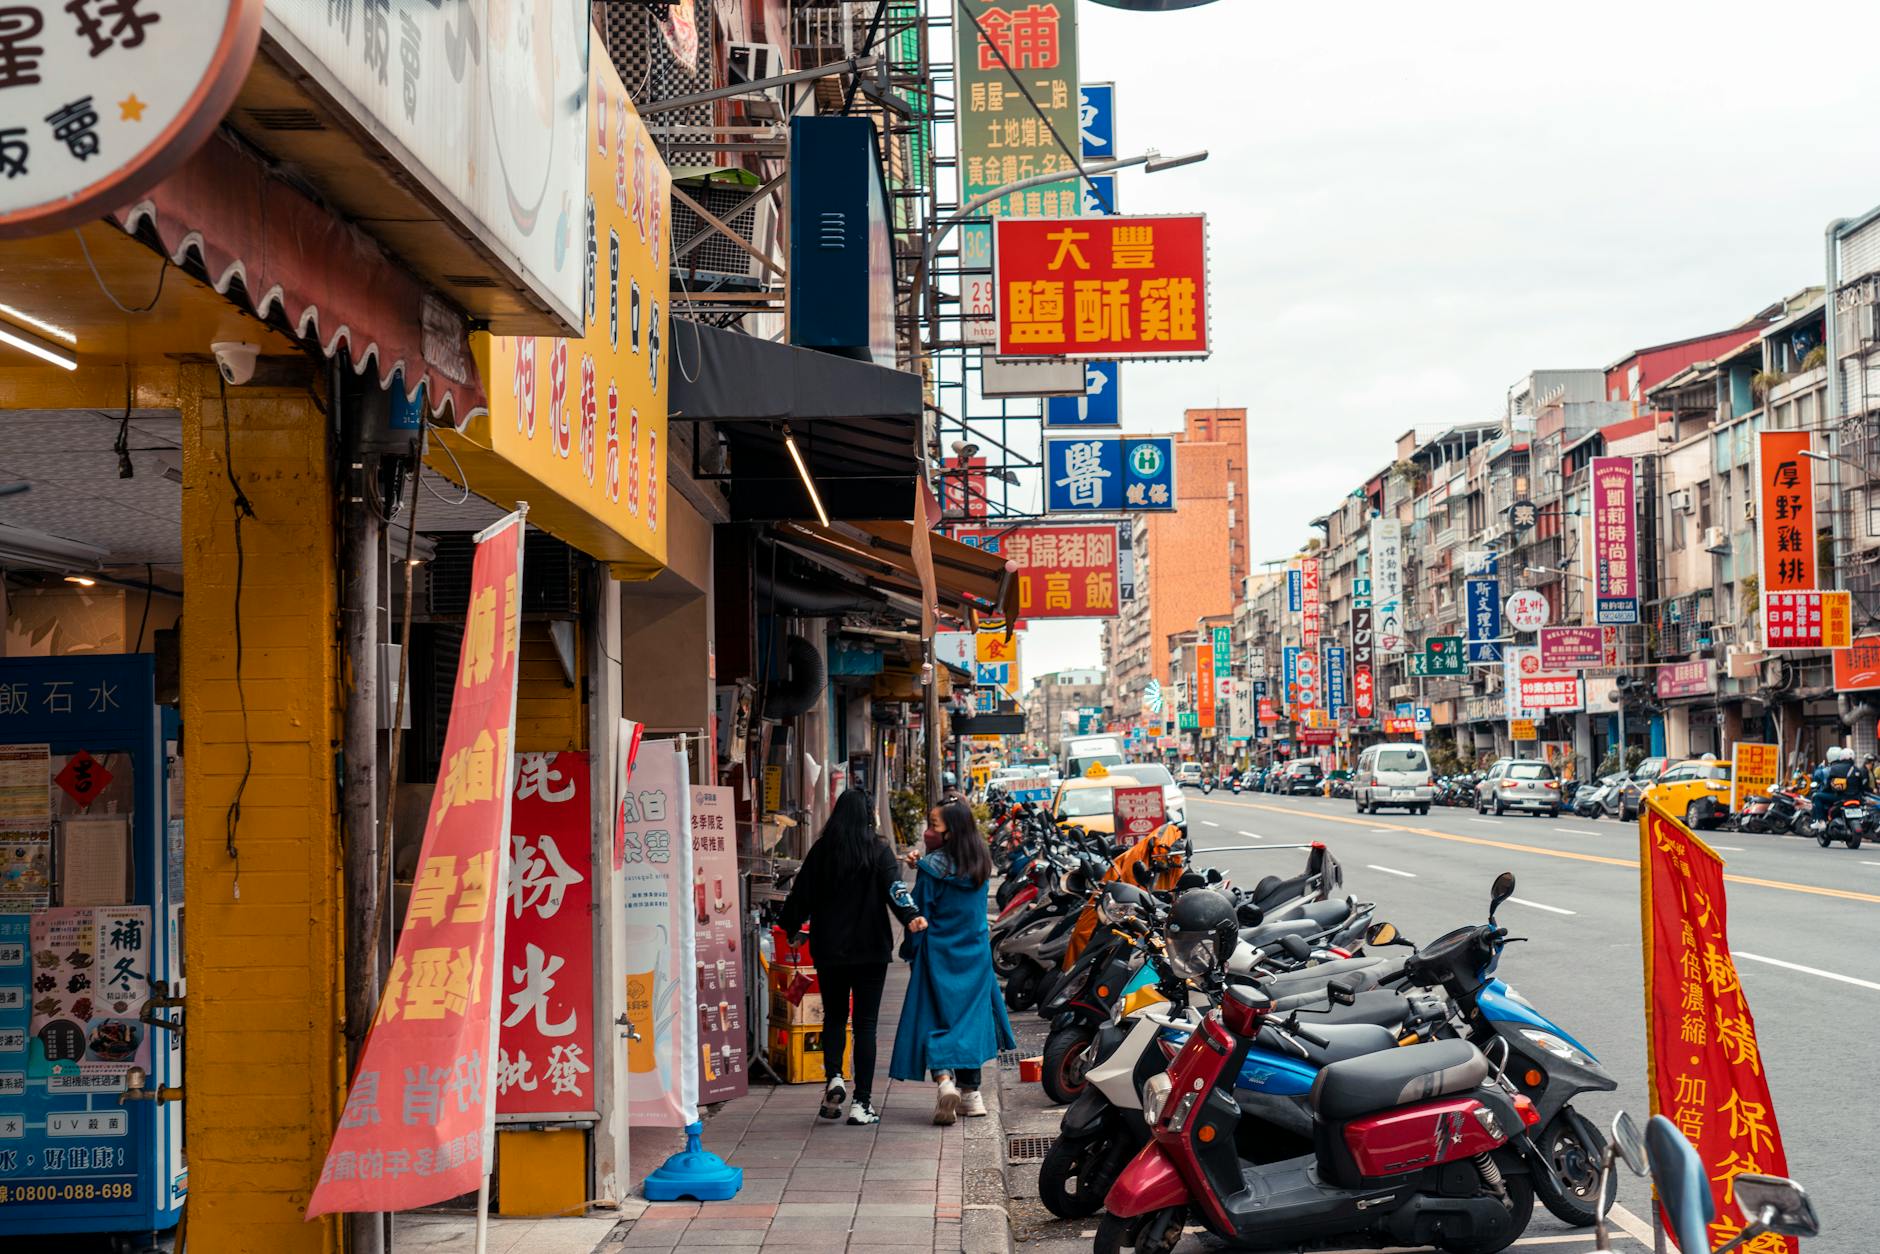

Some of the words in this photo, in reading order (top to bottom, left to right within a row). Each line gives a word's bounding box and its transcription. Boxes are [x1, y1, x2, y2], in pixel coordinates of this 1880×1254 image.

[1009, 277, 1197, 344] 鹽酥雞
[1004, 533, 1112, 568] 當歸豬腳
[1606, 489, 1628, 596] 凱莉時尚藝術
[1773, 460, 1804, 585] 厚野雞排
[691, 814, 724, 832] 冬季限定
[496, 1043, 590, 1098] 批發
